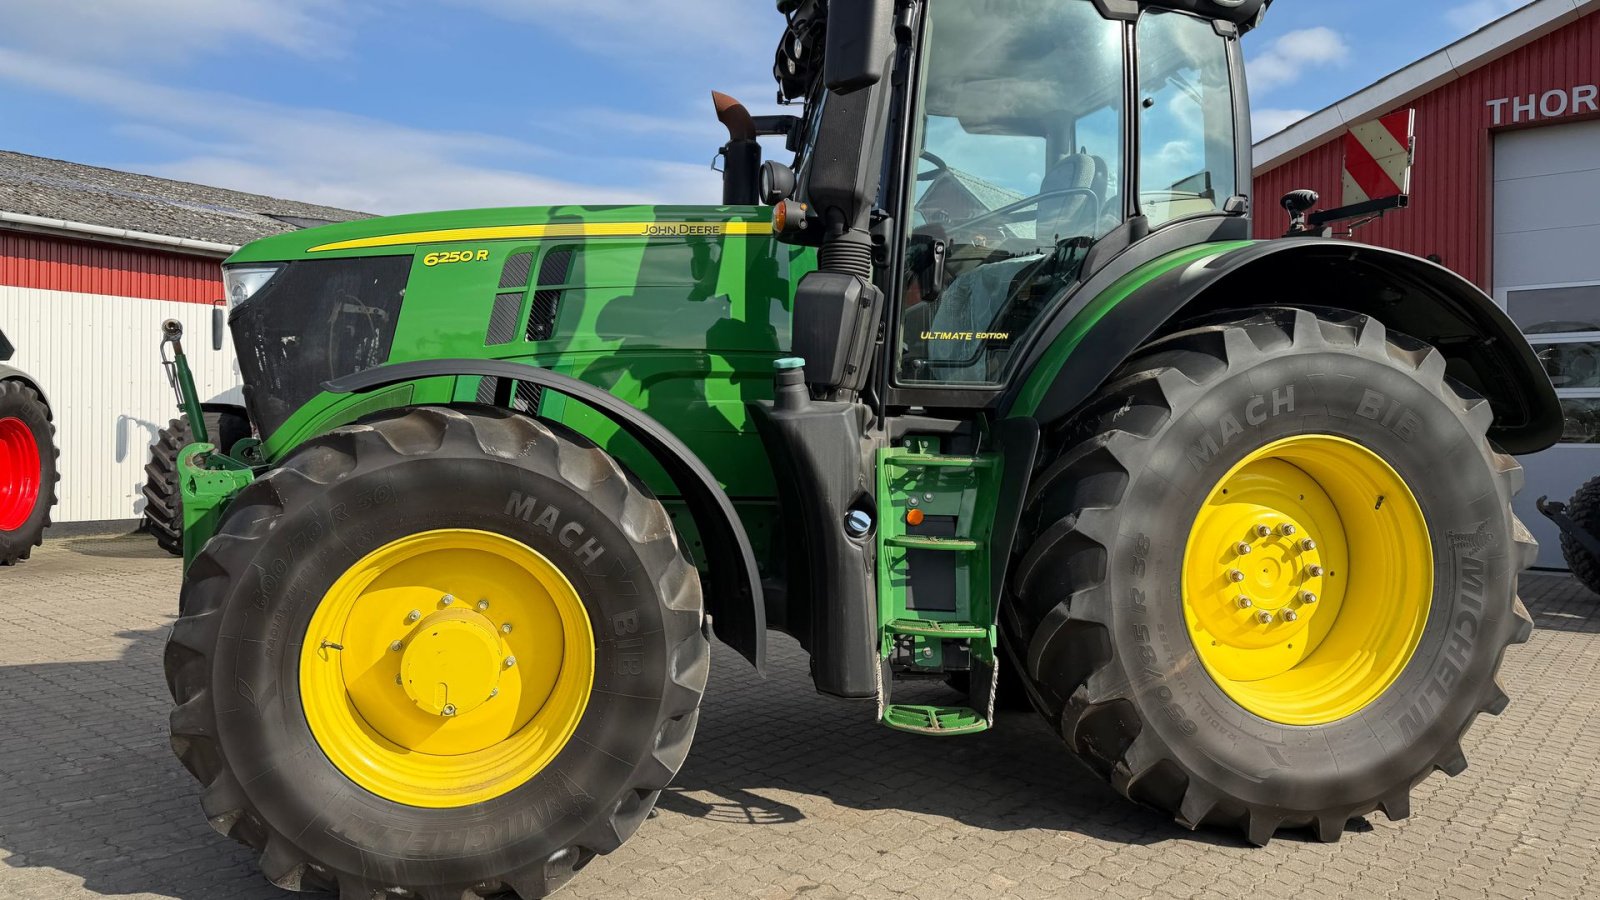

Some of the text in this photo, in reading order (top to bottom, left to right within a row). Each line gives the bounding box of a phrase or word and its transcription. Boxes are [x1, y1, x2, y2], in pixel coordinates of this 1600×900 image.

[1486, 84, 1599, 125] THOR
[641, 224, 720, 236] JOHN DEERE
[423, 249, 490, 267] 6250 R
[920, 331, 1010, 341] ULTIMATE EDITION
[1186, 384, 1424, 473] MACH BIB
[503, 490, 645, 677] MACH BIB
[1397, 555, 1486, 747] MICHELIN
